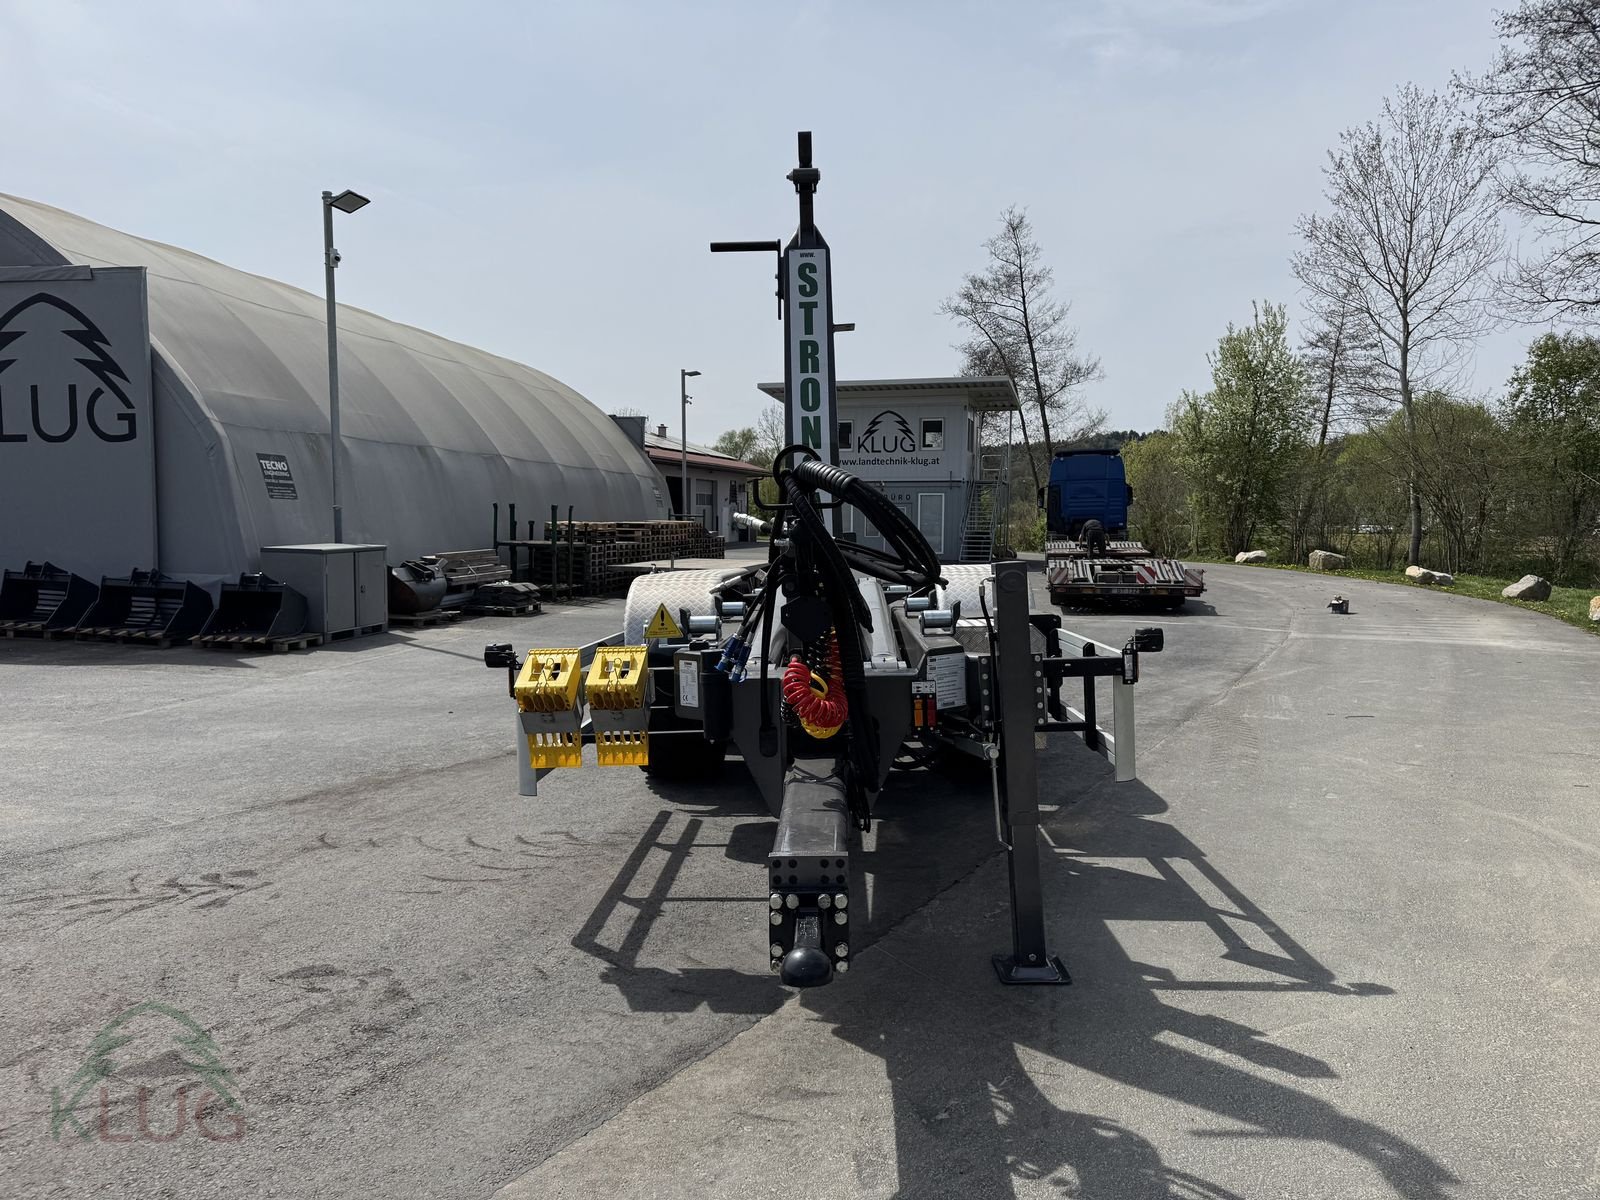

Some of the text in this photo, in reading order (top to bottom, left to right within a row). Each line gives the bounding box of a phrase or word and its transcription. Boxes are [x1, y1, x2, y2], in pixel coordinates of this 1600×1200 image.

[797, 262, 822, 463] STRON
[857, 435, 916, 453] KLUG
[259, 459, 288, 471] TECNO
